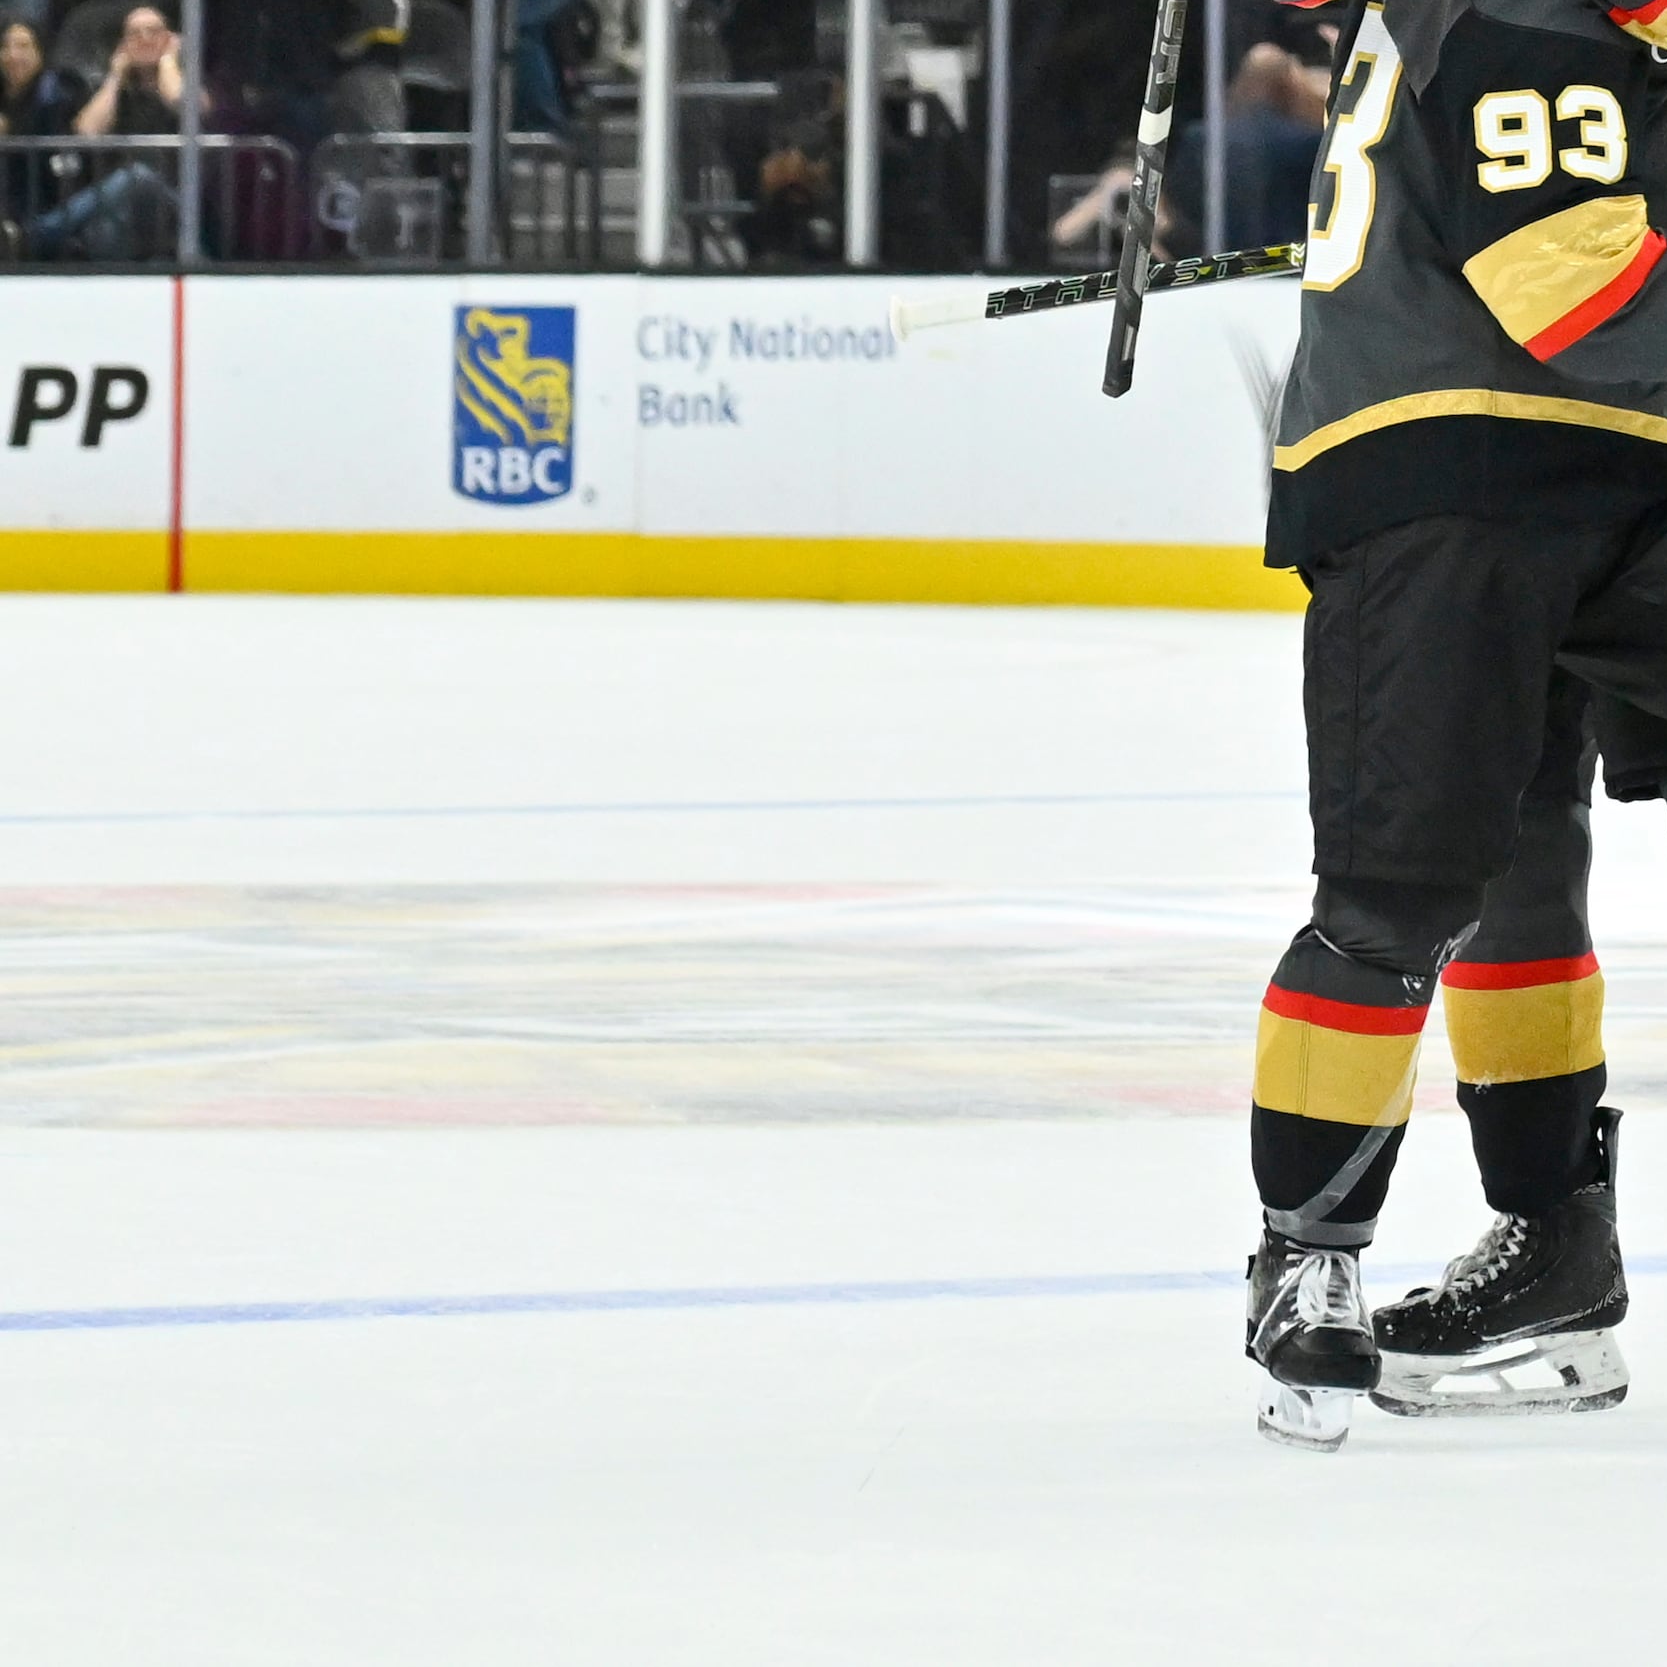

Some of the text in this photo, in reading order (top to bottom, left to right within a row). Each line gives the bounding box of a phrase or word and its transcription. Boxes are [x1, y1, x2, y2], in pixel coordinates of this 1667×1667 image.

[1473, 85, 1628, 194] 93
[635, 315, 897, 371] City National
[9, 366, 150, 448] PP
[637, 383, 741, 426] Bank
[463, 446, 566, 495] RBC
